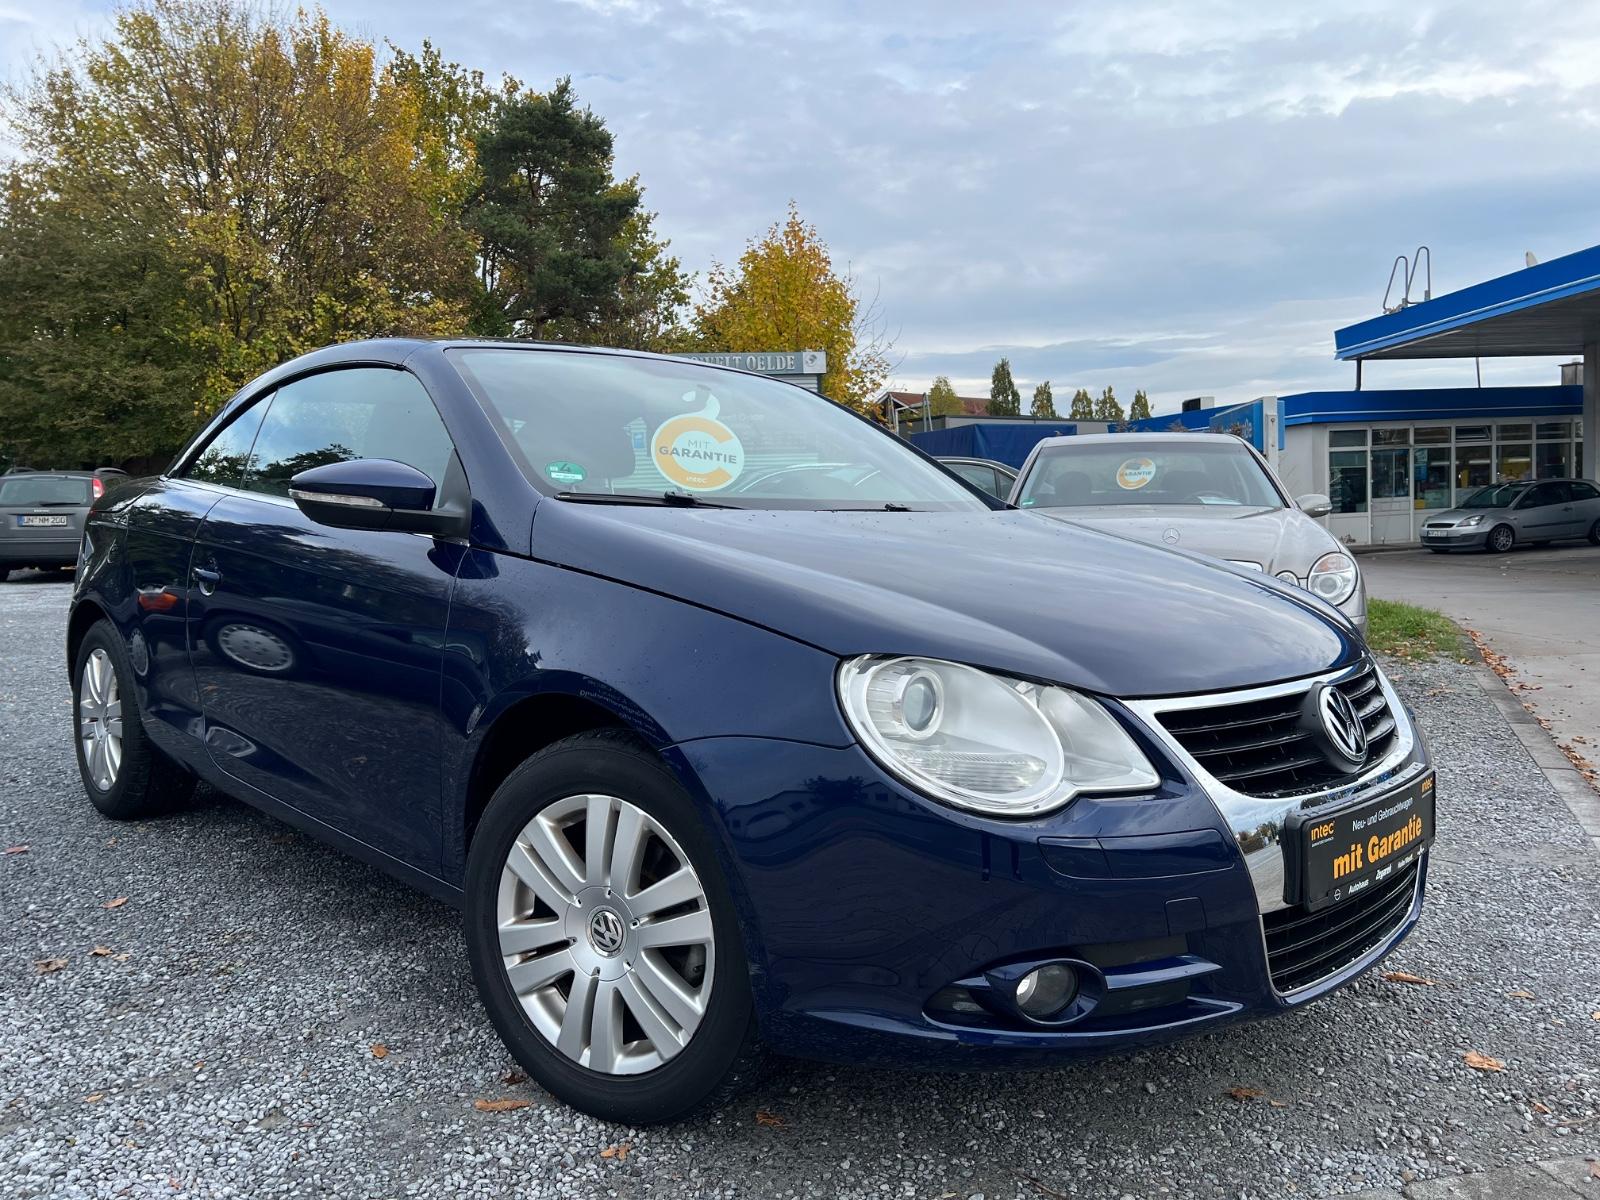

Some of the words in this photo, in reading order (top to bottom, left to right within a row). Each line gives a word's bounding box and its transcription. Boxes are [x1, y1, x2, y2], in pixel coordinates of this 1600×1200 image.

[746, 355, 795, 371] OELDE
[687, 439, 711, 448] MIT
[659, 445, 737, 464] GARANTIE
[1367, 813, 1377, 826] und
[1333, 843, 1363, 879] mit
[1367, 814, 1422, 863] Garantie
[1348, 879, 1369, 894] Autohaus
